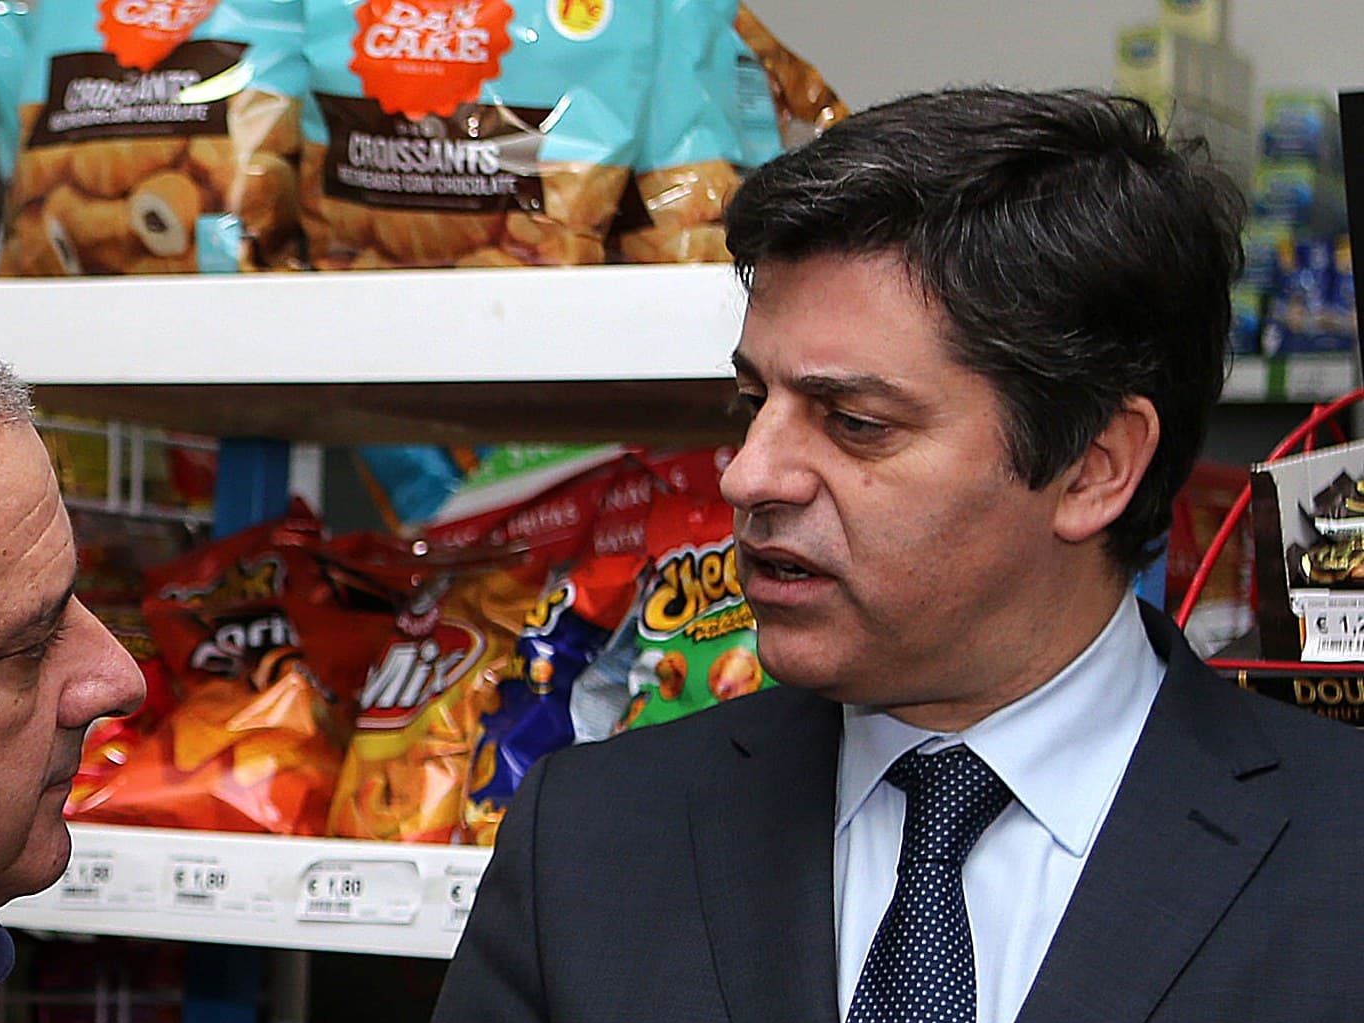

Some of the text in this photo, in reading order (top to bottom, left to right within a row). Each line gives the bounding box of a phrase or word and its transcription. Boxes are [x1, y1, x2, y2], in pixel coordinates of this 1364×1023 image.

[363, 26, 489, 63] CAKE
[348, 132, 501, 175] CROISSANTS
[1316, 612, 1329, 634] €
